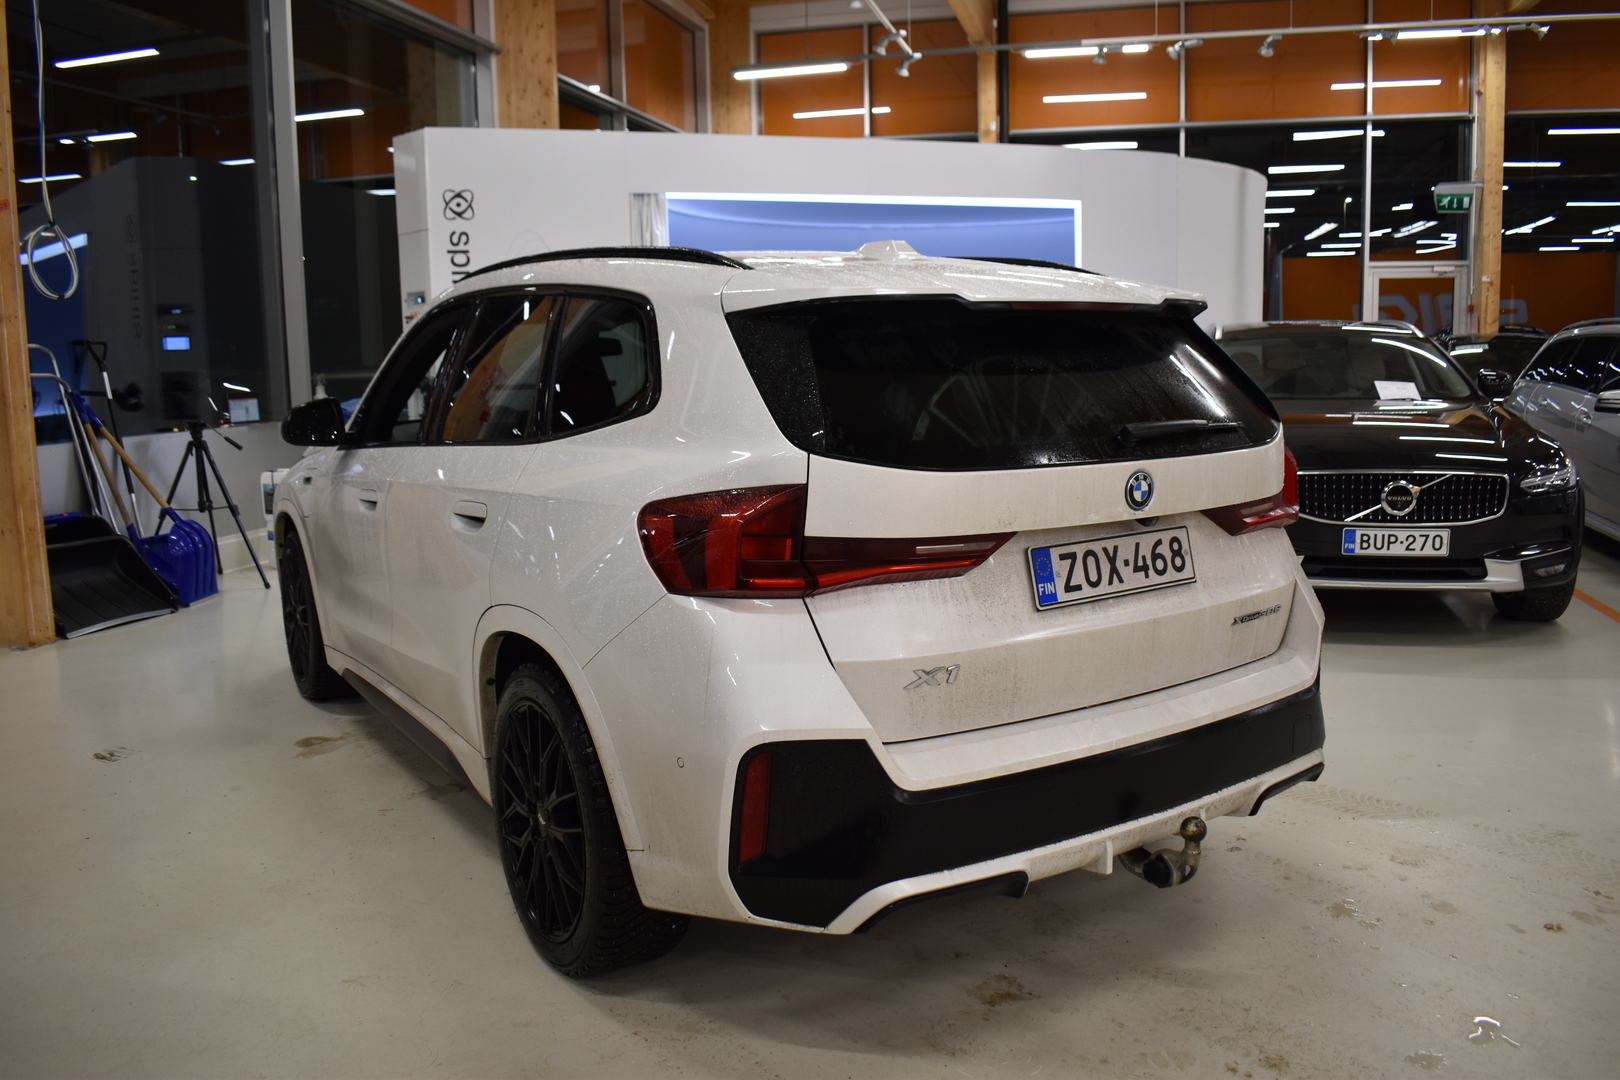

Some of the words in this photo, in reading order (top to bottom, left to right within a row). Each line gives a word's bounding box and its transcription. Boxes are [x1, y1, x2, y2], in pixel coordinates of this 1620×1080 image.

[1359, 533, 1444, 552] BUP-270
[1058, 536, 1186, 593] ZOX-468
[1038, 581, 1056, 597] FIN
[903, 663, 961, 690] X1
